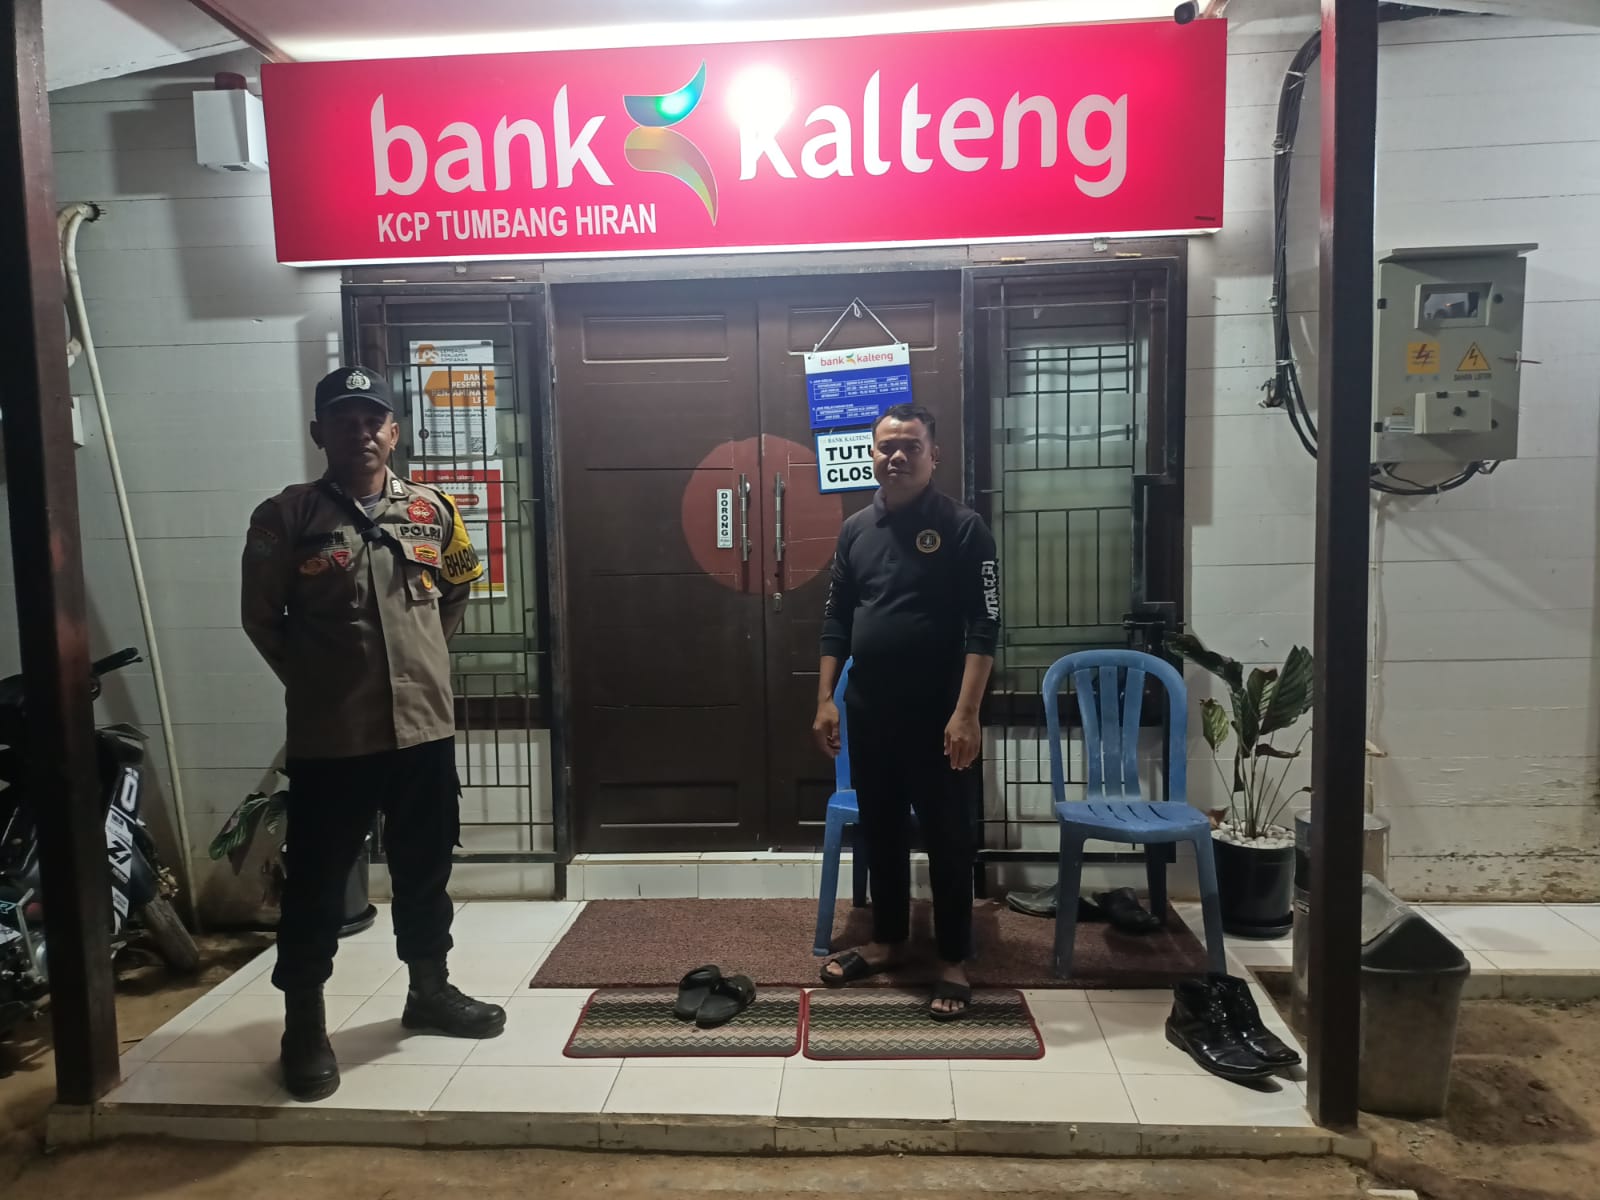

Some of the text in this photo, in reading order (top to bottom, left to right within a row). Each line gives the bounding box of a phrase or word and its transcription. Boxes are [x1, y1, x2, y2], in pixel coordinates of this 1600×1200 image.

[370, 69, 1129, 198] bank kalteng
[377, 203, 658, 243] KCP TUMBANG HIRAN
[820, 352, 894, 367] bank kalteng
[827, 466, 873, 483] CLOS
[721, 492, 729, 537] DORONG
[401, 526, 441, 539] POLRI
